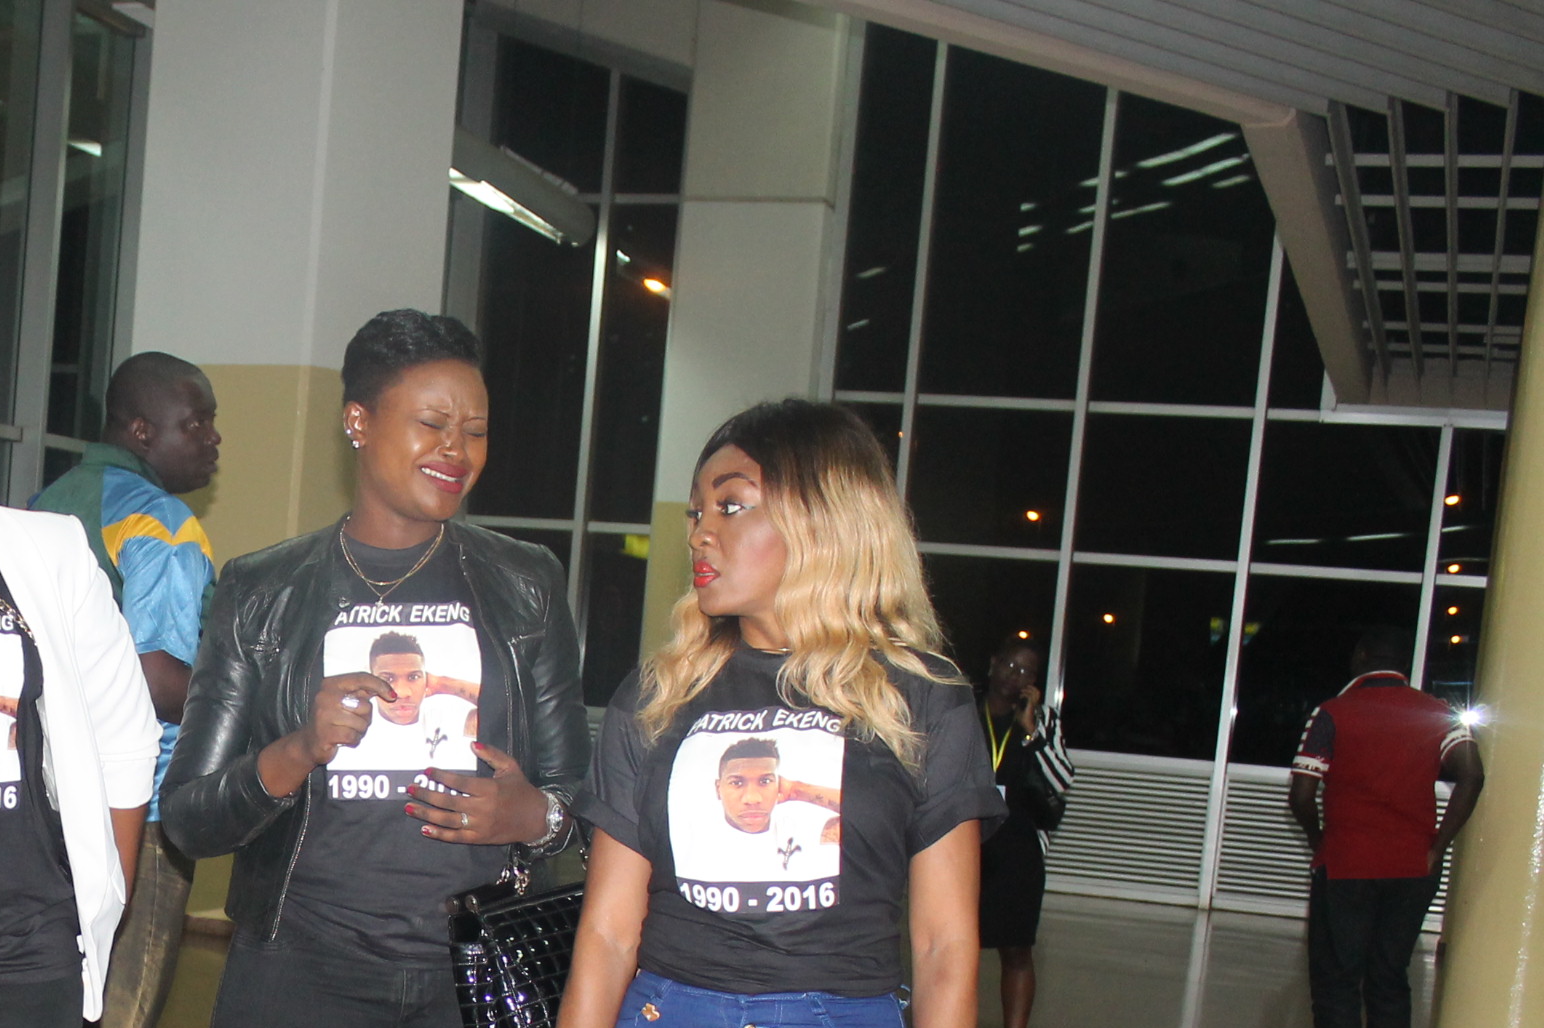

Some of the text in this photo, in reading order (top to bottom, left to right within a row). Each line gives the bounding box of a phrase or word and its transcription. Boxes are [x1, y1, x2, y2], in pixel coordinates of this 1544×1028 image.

[334, 602, 470, 626] ATRICK EKENG
[772, 708, 842, 733] EKENG
[328, 774, 390, 799] 1990
[680, 882, 740, 913] 1990
[766, 882, 835, 912] 2016
